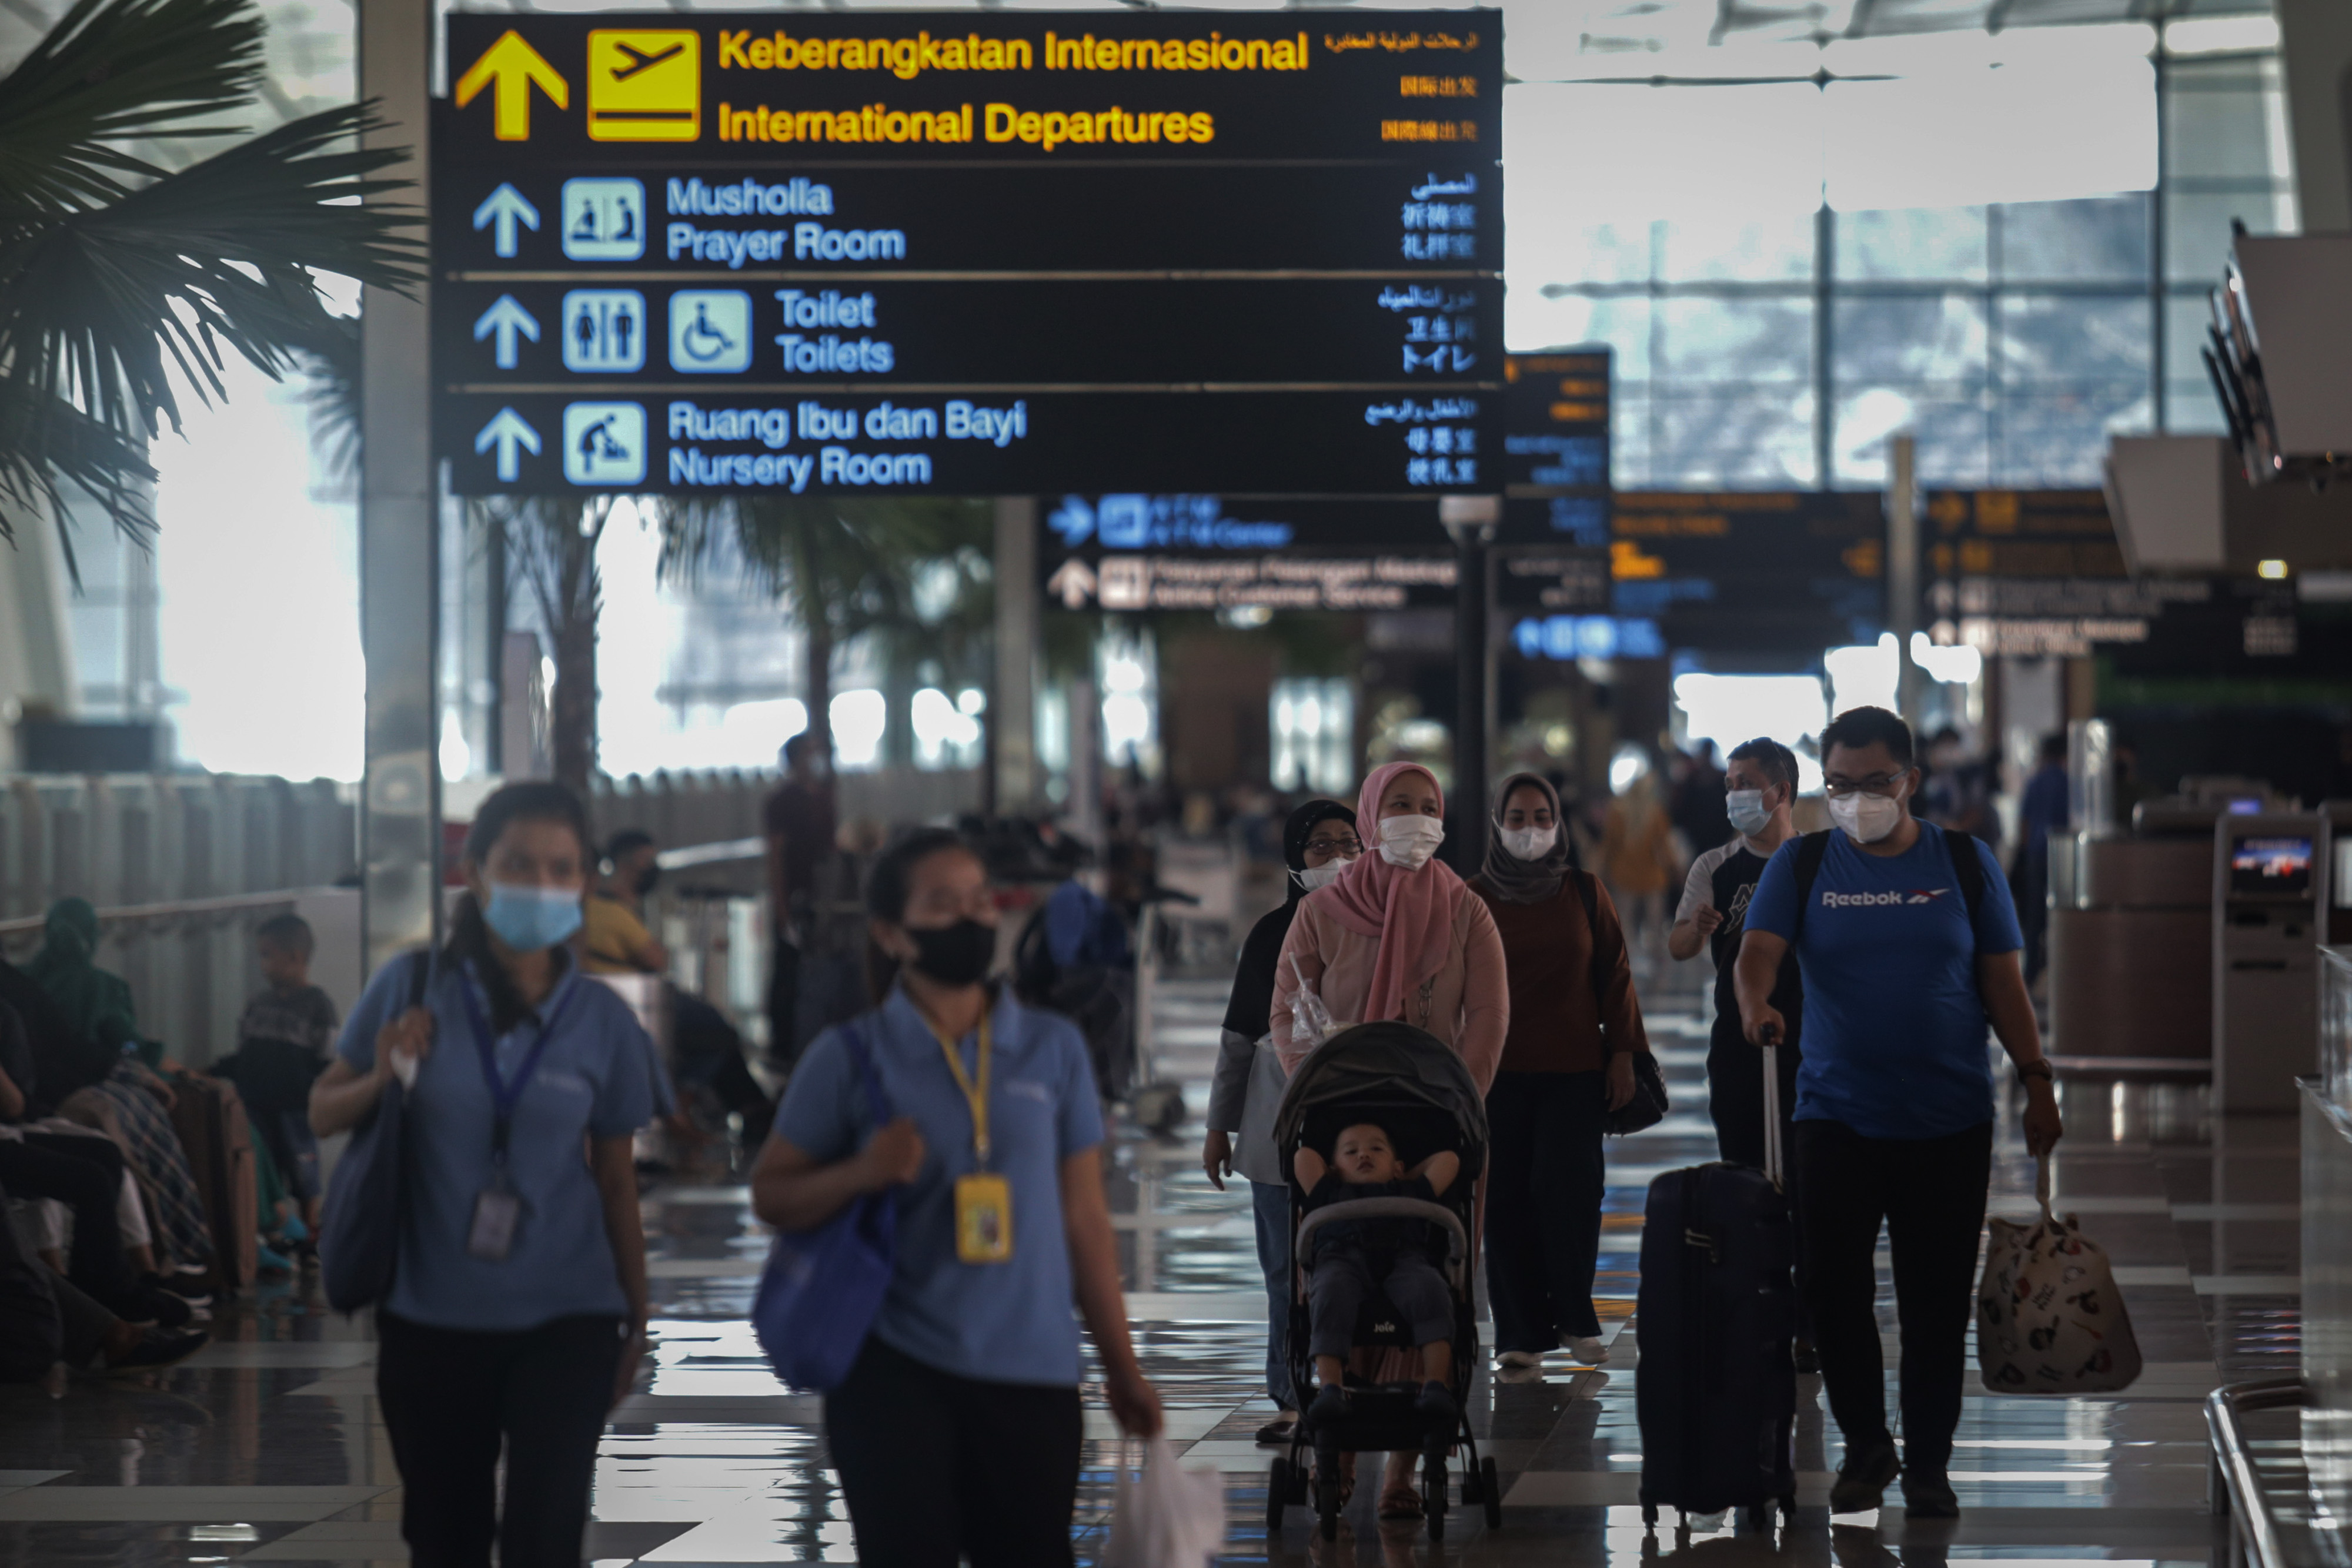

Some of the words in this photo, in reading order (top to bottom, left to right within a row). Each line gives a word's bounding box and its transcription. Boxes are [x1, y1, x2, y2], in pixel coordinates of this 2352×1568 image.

[718, 29, 1034, 81] Keberangkatan
[1044, 30, 1309, 72] Internasional
[1399, 75, 1476, 97] 国际出发
[718, 101, 974, 144] International
[984, 102, 1215, 153] Departures
[666, 176, 836, 217] Musholla
[666, 221, 790, 270] Prayer
[793, 220, 907, 262] Room
[773, 288, 877, 329] Toilet
[773, 333, 896, 374] Toilets
[1401, 343, 1475, 373] トイレ
[667, 400, 791, 450] Ruang
[796, 400, 860, 442] Ibu
[863, 400, 940, 441] dan
[944, 399, 1028, 449] Bayi
[667, 448, 815, 494] Nursery
[819, 447, 933, 486] Room
[1822, 890, 1903, 908] Reebok
